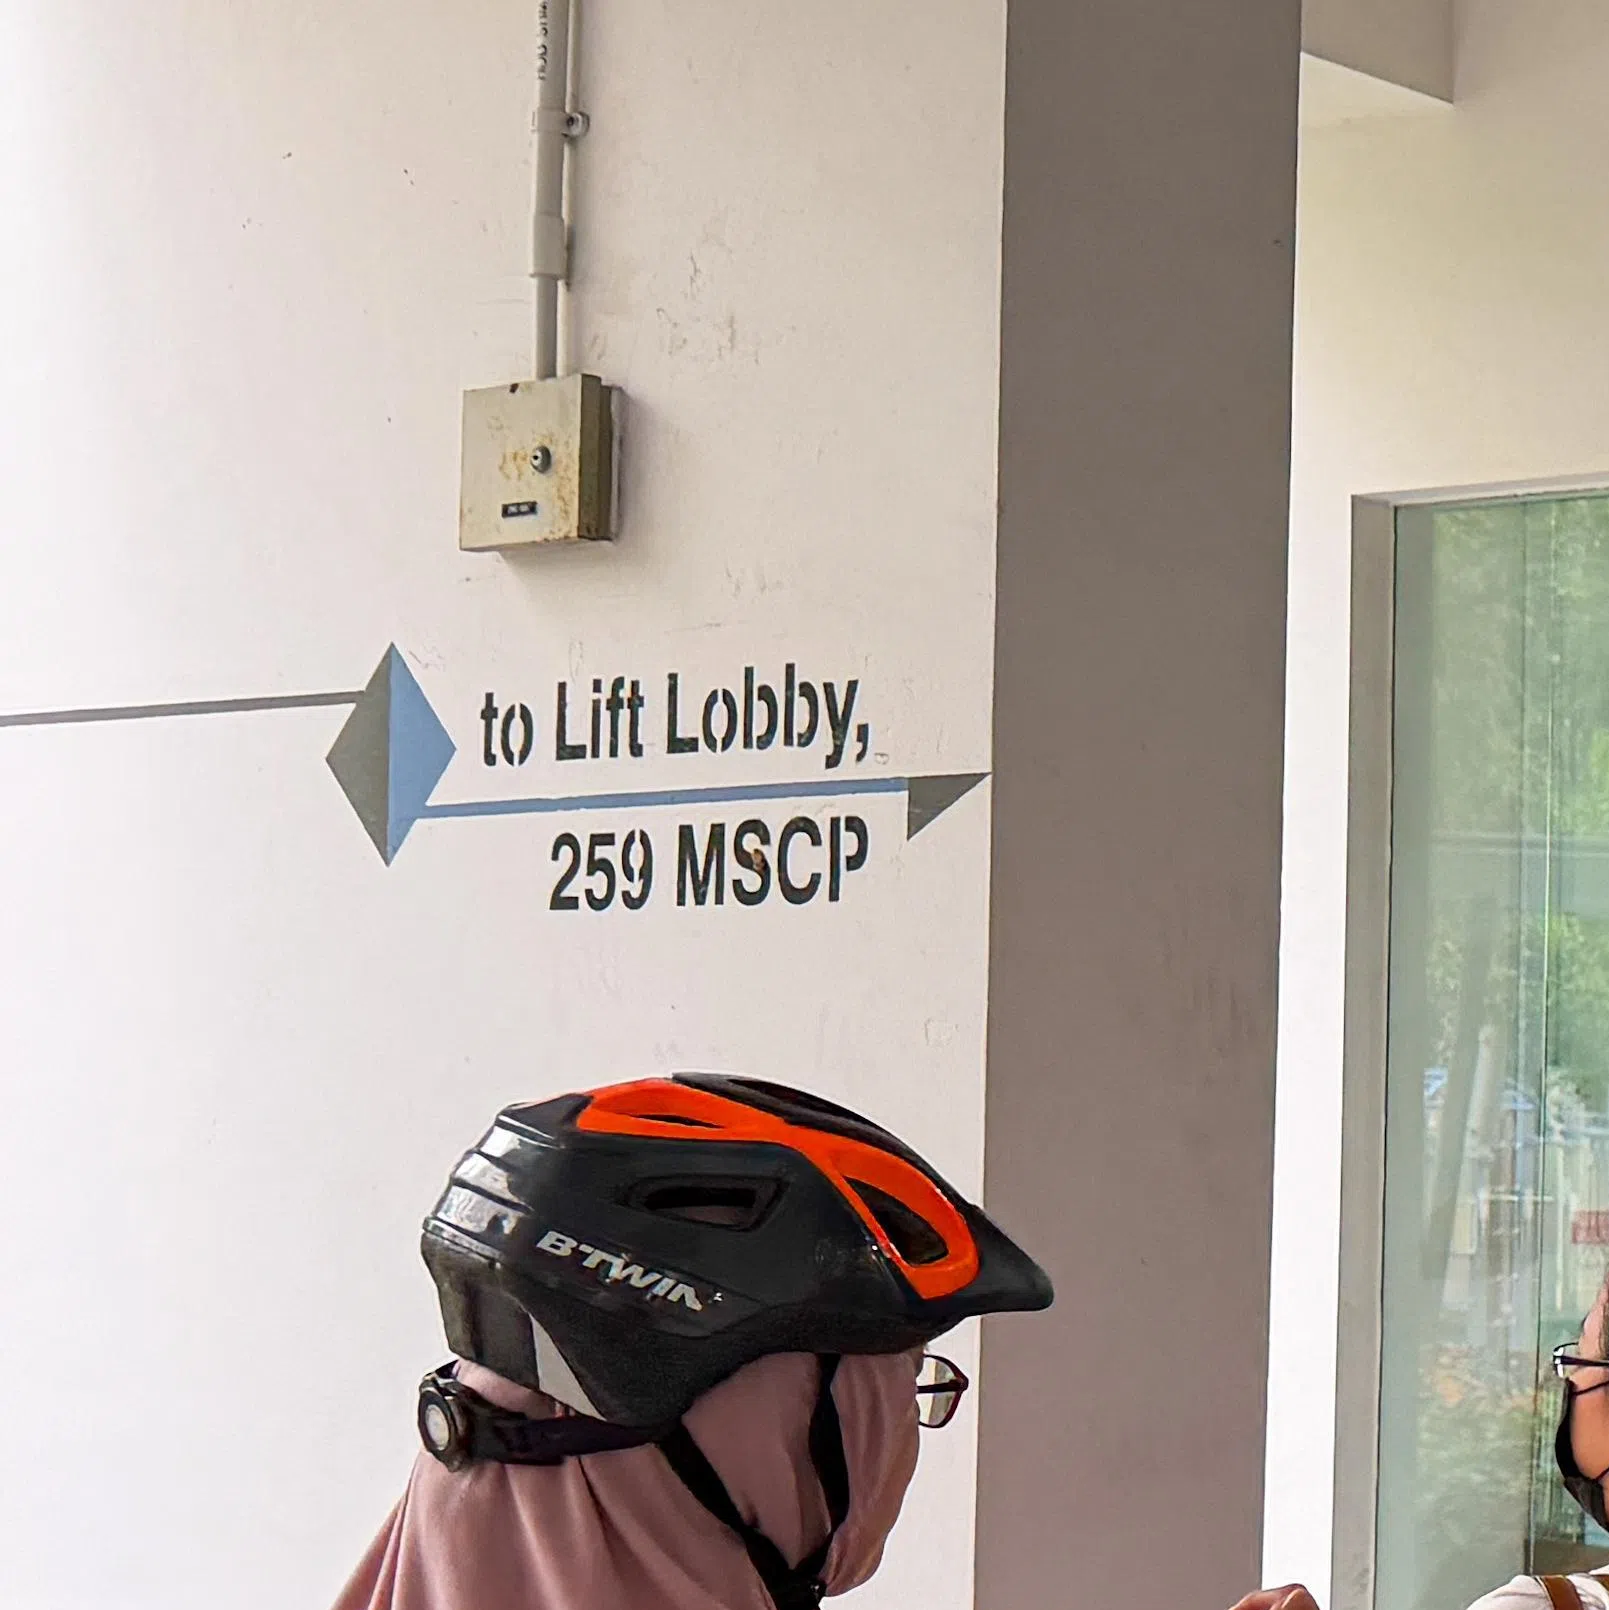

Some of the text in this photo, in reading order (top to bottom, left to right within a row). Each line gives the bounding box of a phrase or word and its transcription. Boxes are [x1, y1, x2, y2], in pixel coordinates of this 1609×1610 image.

[480, 663, 870, 769] to Lift Lobby,
[549, 815, 870, 911] 259 MSCP
